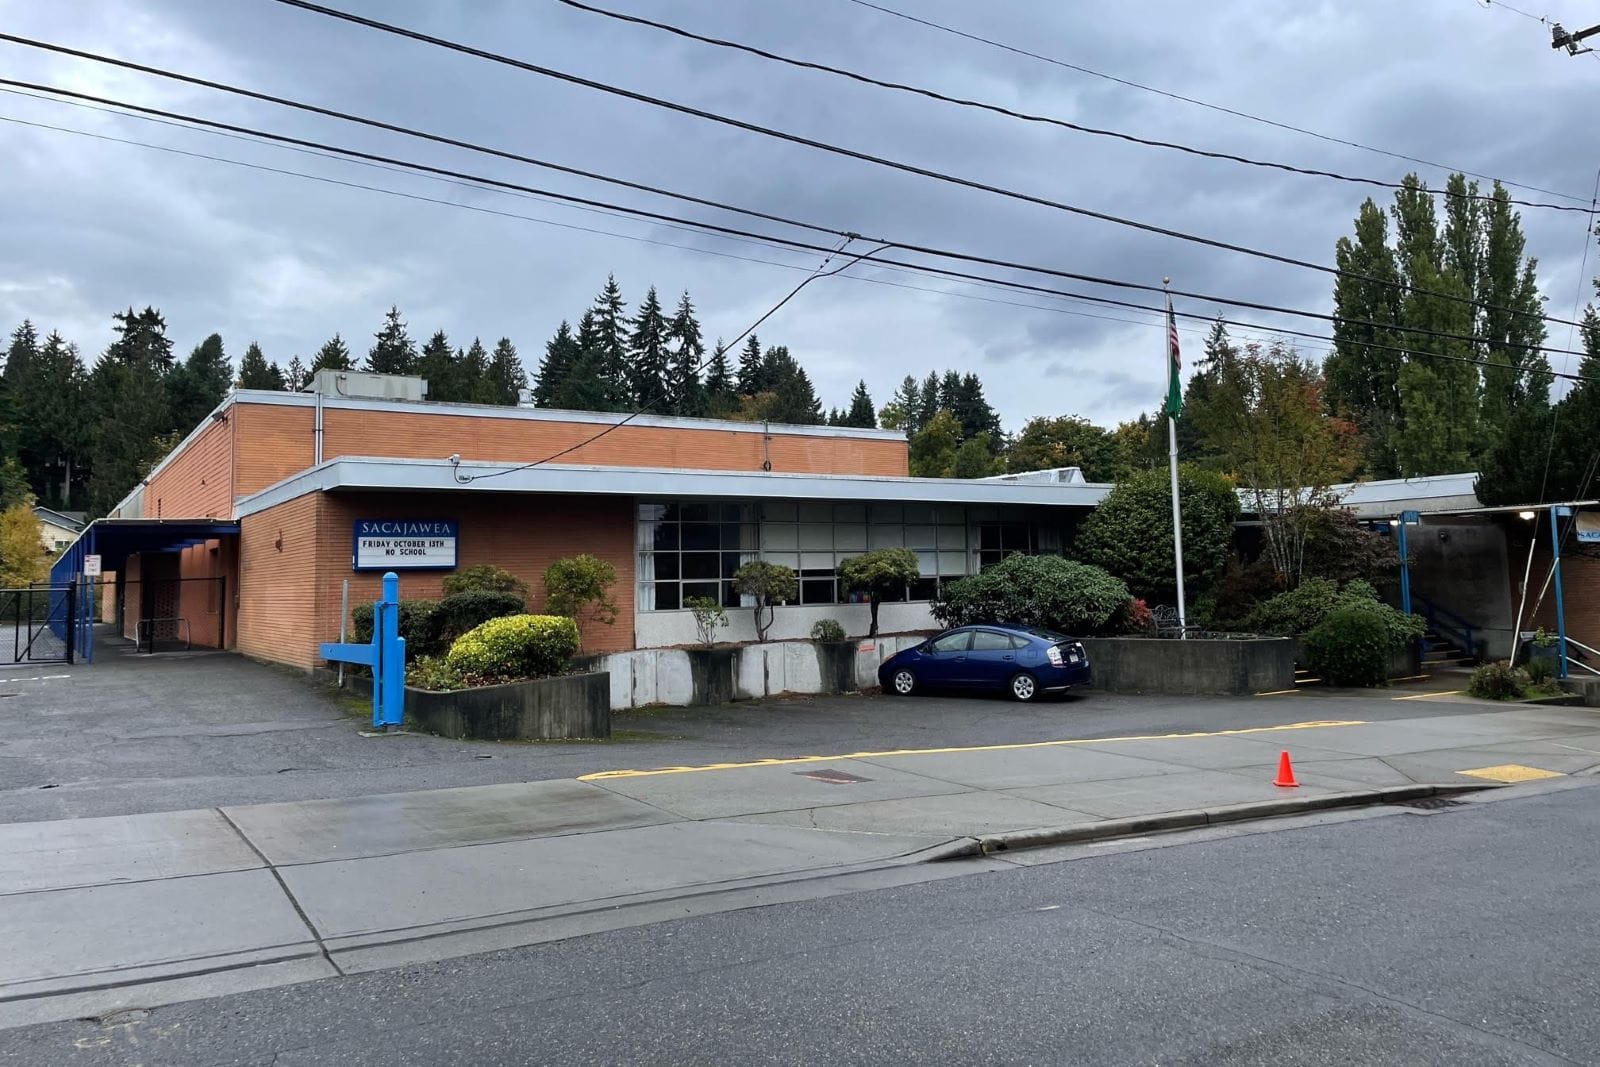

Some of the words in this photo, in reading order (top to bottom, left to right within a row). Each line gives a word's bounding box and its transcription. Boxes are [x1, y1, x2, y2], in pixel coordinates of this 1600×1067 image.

[362, 522, 450, 535] SACAJAWEA
[385, 548, 395, 556] NO
[399, 548, 426, 556] SCHOOL
